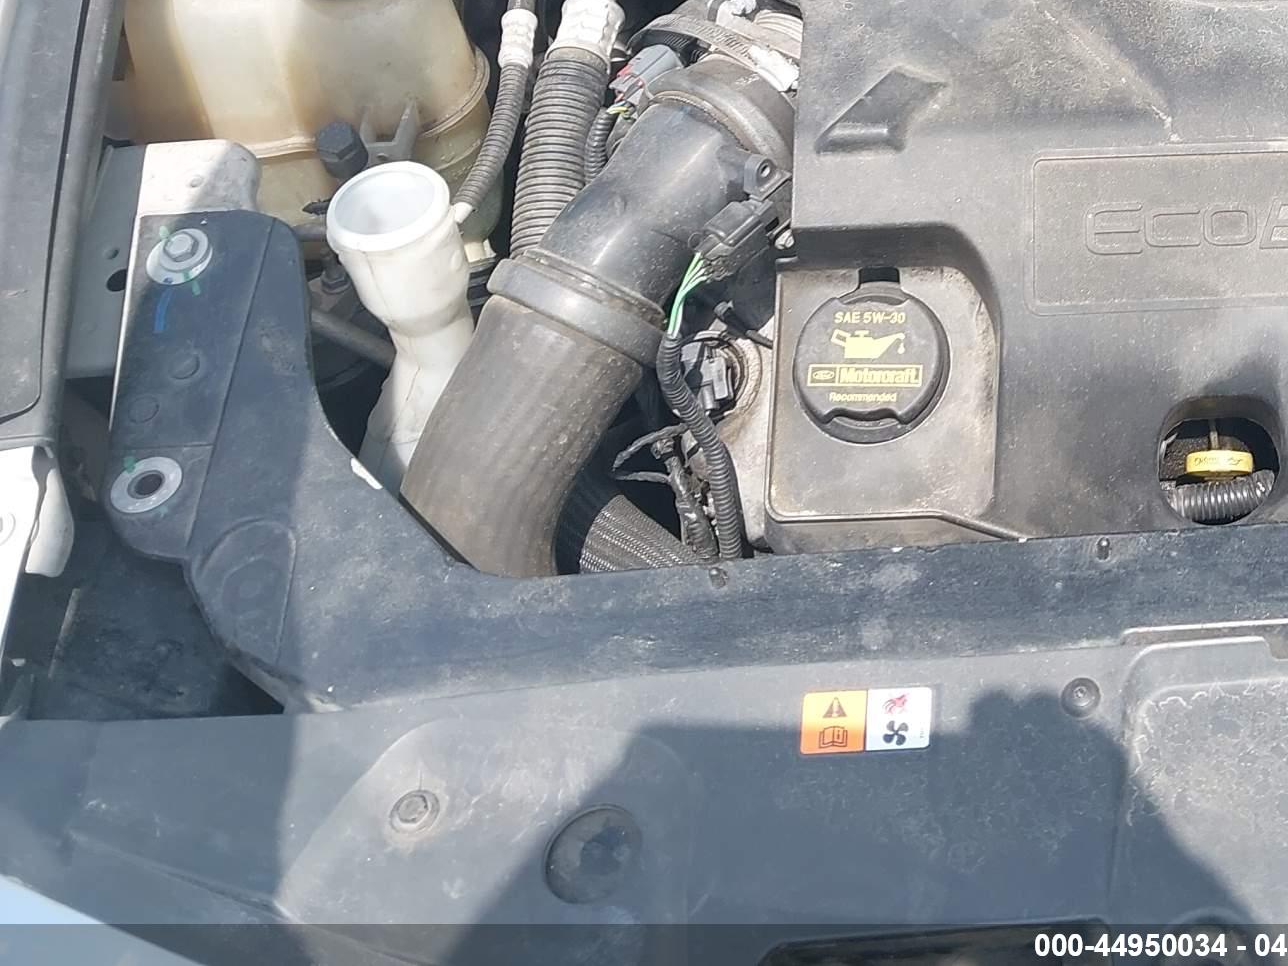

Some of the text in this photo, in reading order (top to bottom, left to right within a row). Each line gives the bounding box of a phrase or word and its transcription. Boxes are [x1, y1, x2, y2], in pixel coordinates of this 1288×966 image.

[834, 311, 906, 324] SAE 5W-30
[829, 392, 897, 402] Recommended
